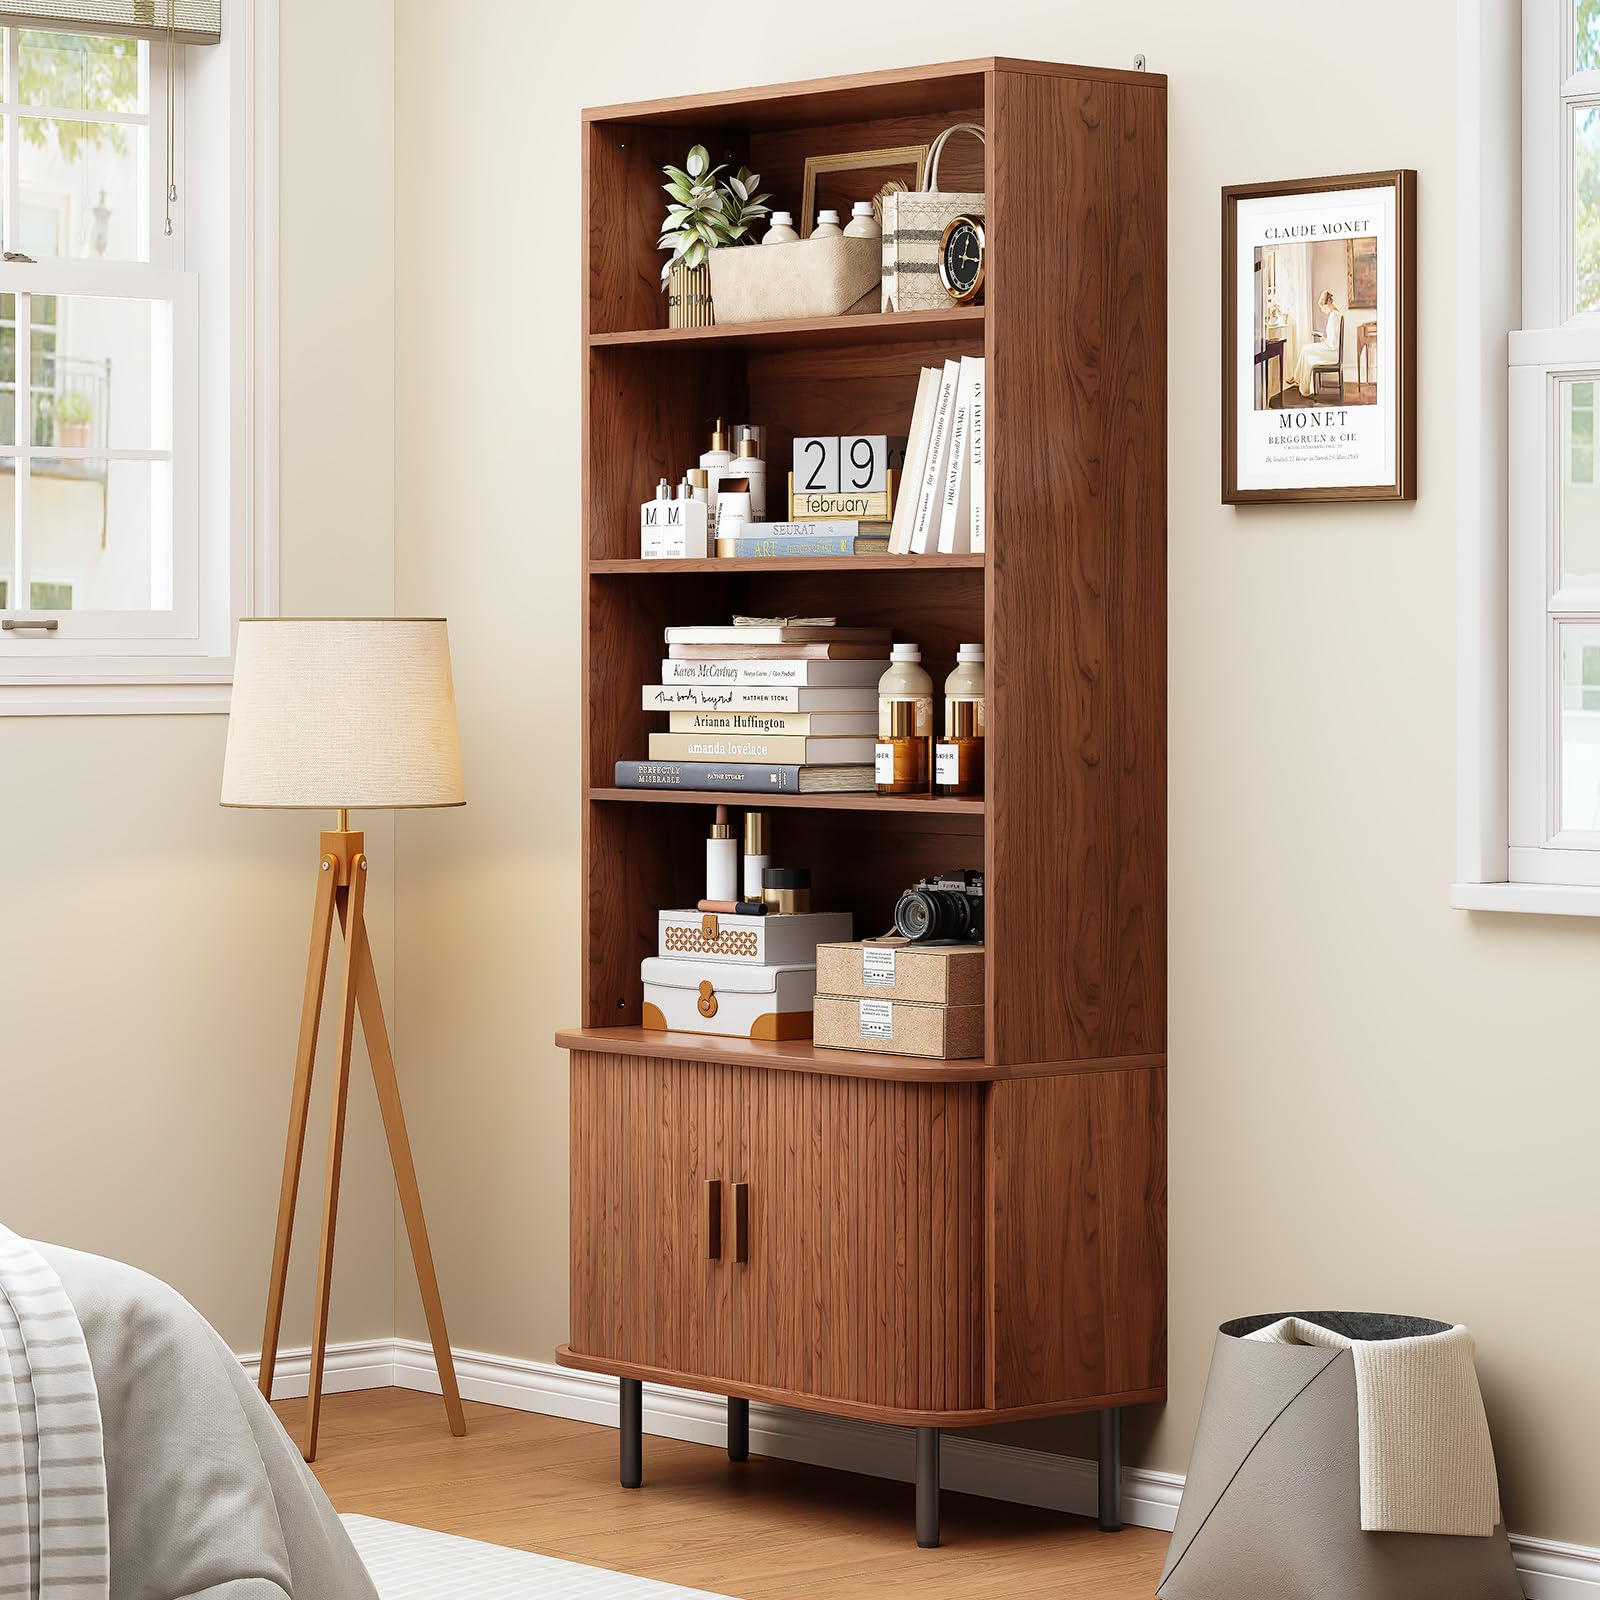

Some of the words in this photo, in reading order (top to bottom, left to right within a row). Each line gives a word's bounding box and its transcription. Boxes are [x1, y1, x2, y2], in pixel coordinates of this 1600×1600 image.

[1265, 224, 1317, 239] CLAUDE
[1322, 219, 1370, 235] MONET
[974, 382, 982, 397] ON
[1279, 411, 1348, 429] MONET
[926, 473, 935, 486] for
[931, 417, 945, 466] sustainable
[940, 382, 952, 416] lifestyle
[974, 404, 982, 465] IMMUNITY
[1268, 434, 1327, 445] BERGGRUEN
[1329, 434, 1336, 442] &
[1340, 433, 1357, 442] CIE
[947, 470, 958, 506] DREAM
[955, 406, 966, 440] AWAKE
[805, 494, 869, 517] february
[645, 507, 657, 525] M
[667, 506, 679, 525] M
[773, 524, 816, 536] SEURAT
[754, 540, 778, 558] ART
[673, 663, 696, 678] Karen
[698, 664, 738, 682] McCartney
[654, 690, 674, 703] The
[676, 688, 698, 704] body
[701, 691, 733, 710] beyond
[743, 694, 769, 702] MATTHEW
[693, 714, 730, 728] Arianna
[733, 715, 785, 732] Huffington
[688, 741, 725, 755] amanda
[728, 742, 768, 756] lovelace
[637, 764, 681, 775] PERFECTLY
[638, 775, 681, 784] MISERABLE
